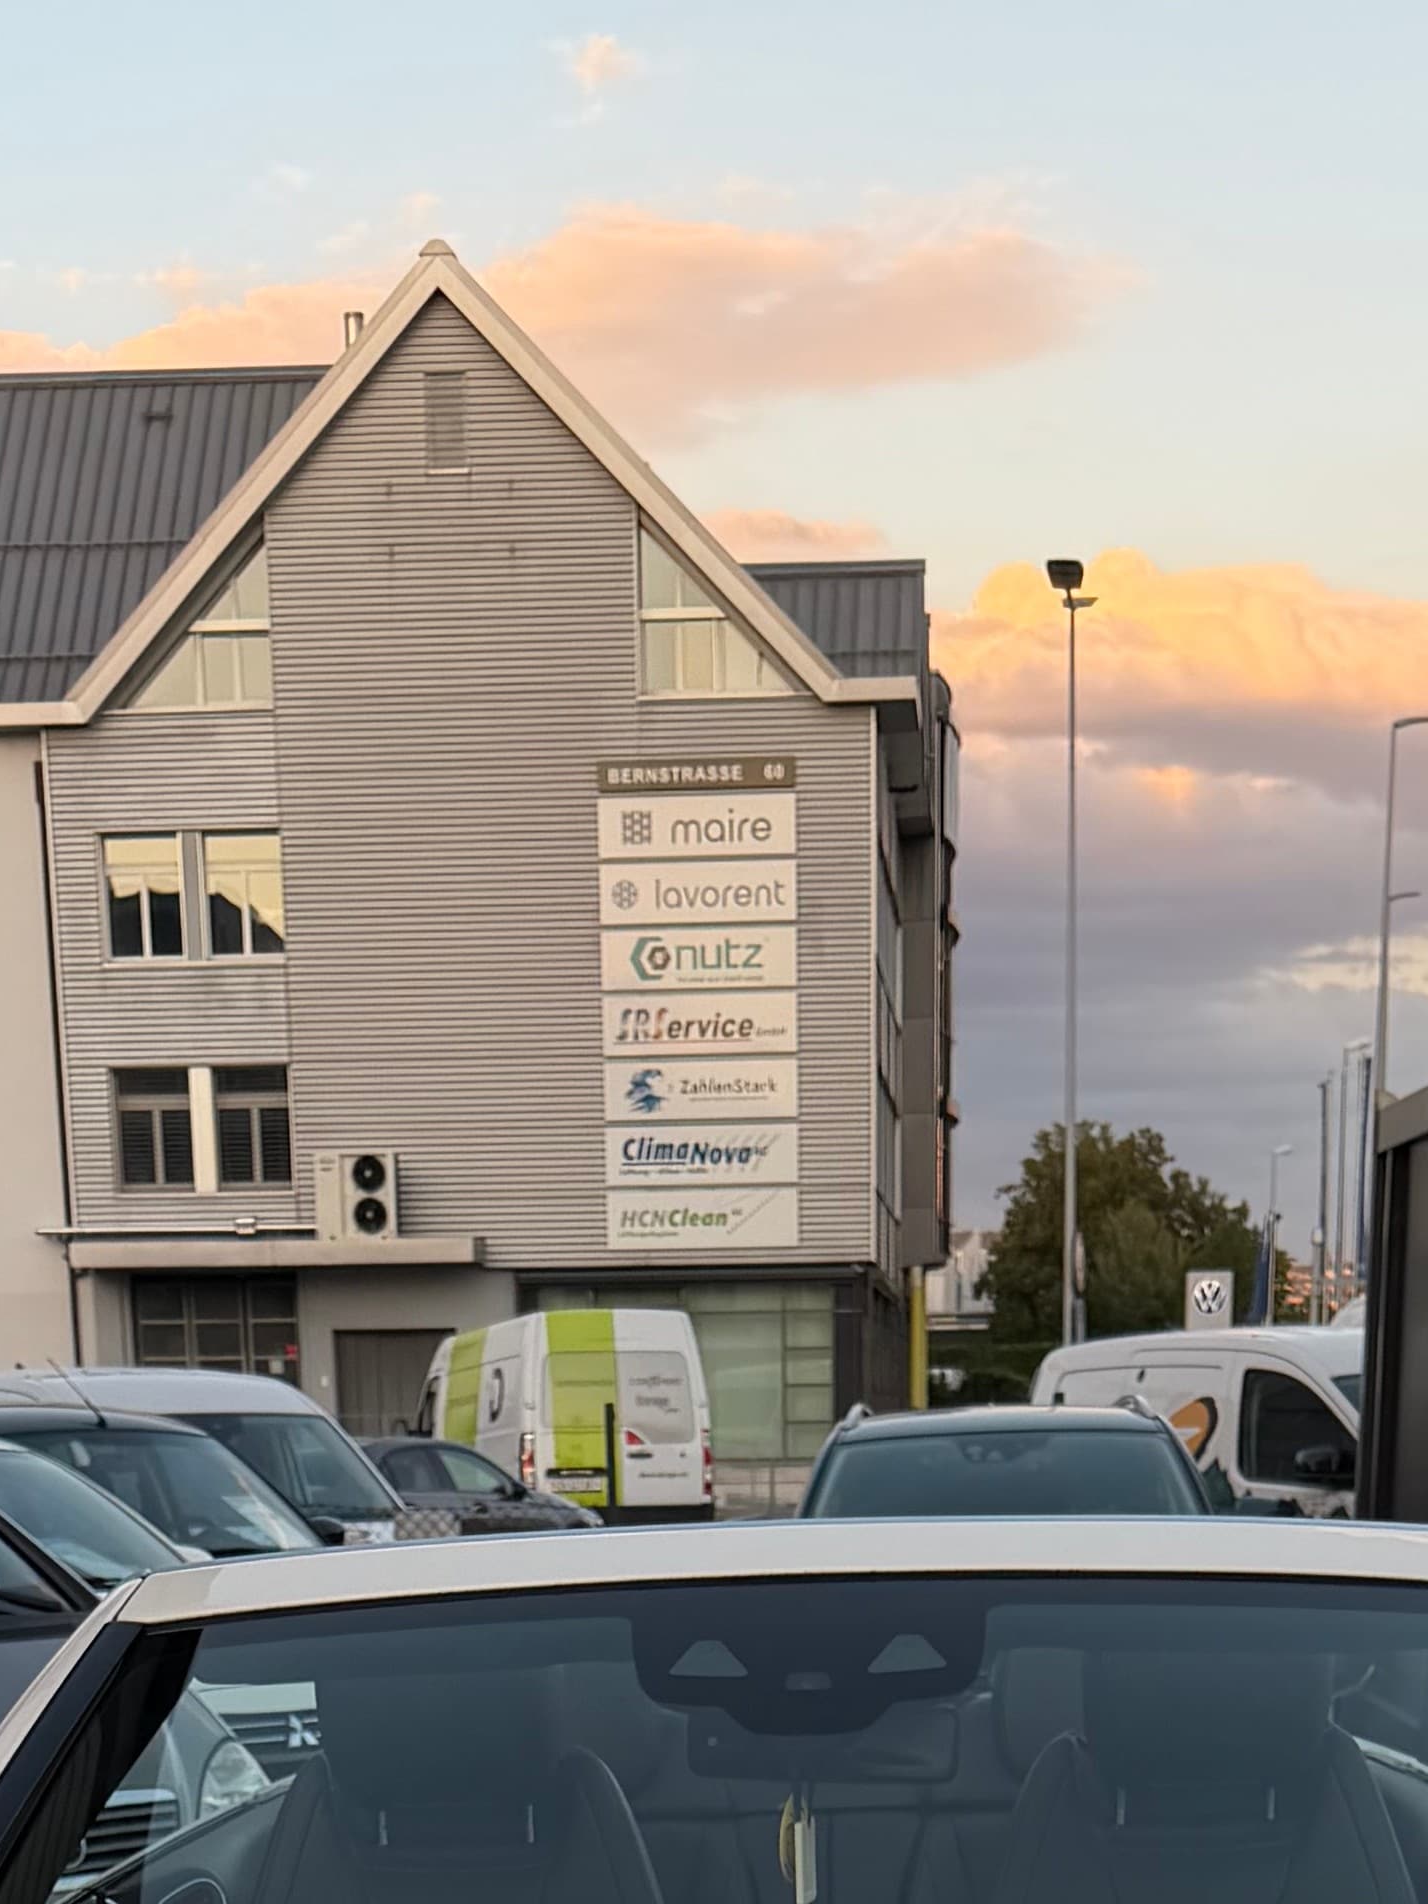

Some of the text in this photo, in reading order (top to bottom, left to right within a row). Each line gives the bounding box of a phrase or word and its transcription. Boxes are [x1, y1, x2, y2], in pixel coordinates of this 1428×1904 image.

[606, 763, 786, 784] BERNSTRASSE 60
[671, 807, 772, 845] maire
[654, 878, 786, 910] lavorent
[675, 938, 764, 970] nutz
[622, 1136, 752, 1165] ClimaNova
[621, 1207, 729, 1228] HCNClean
